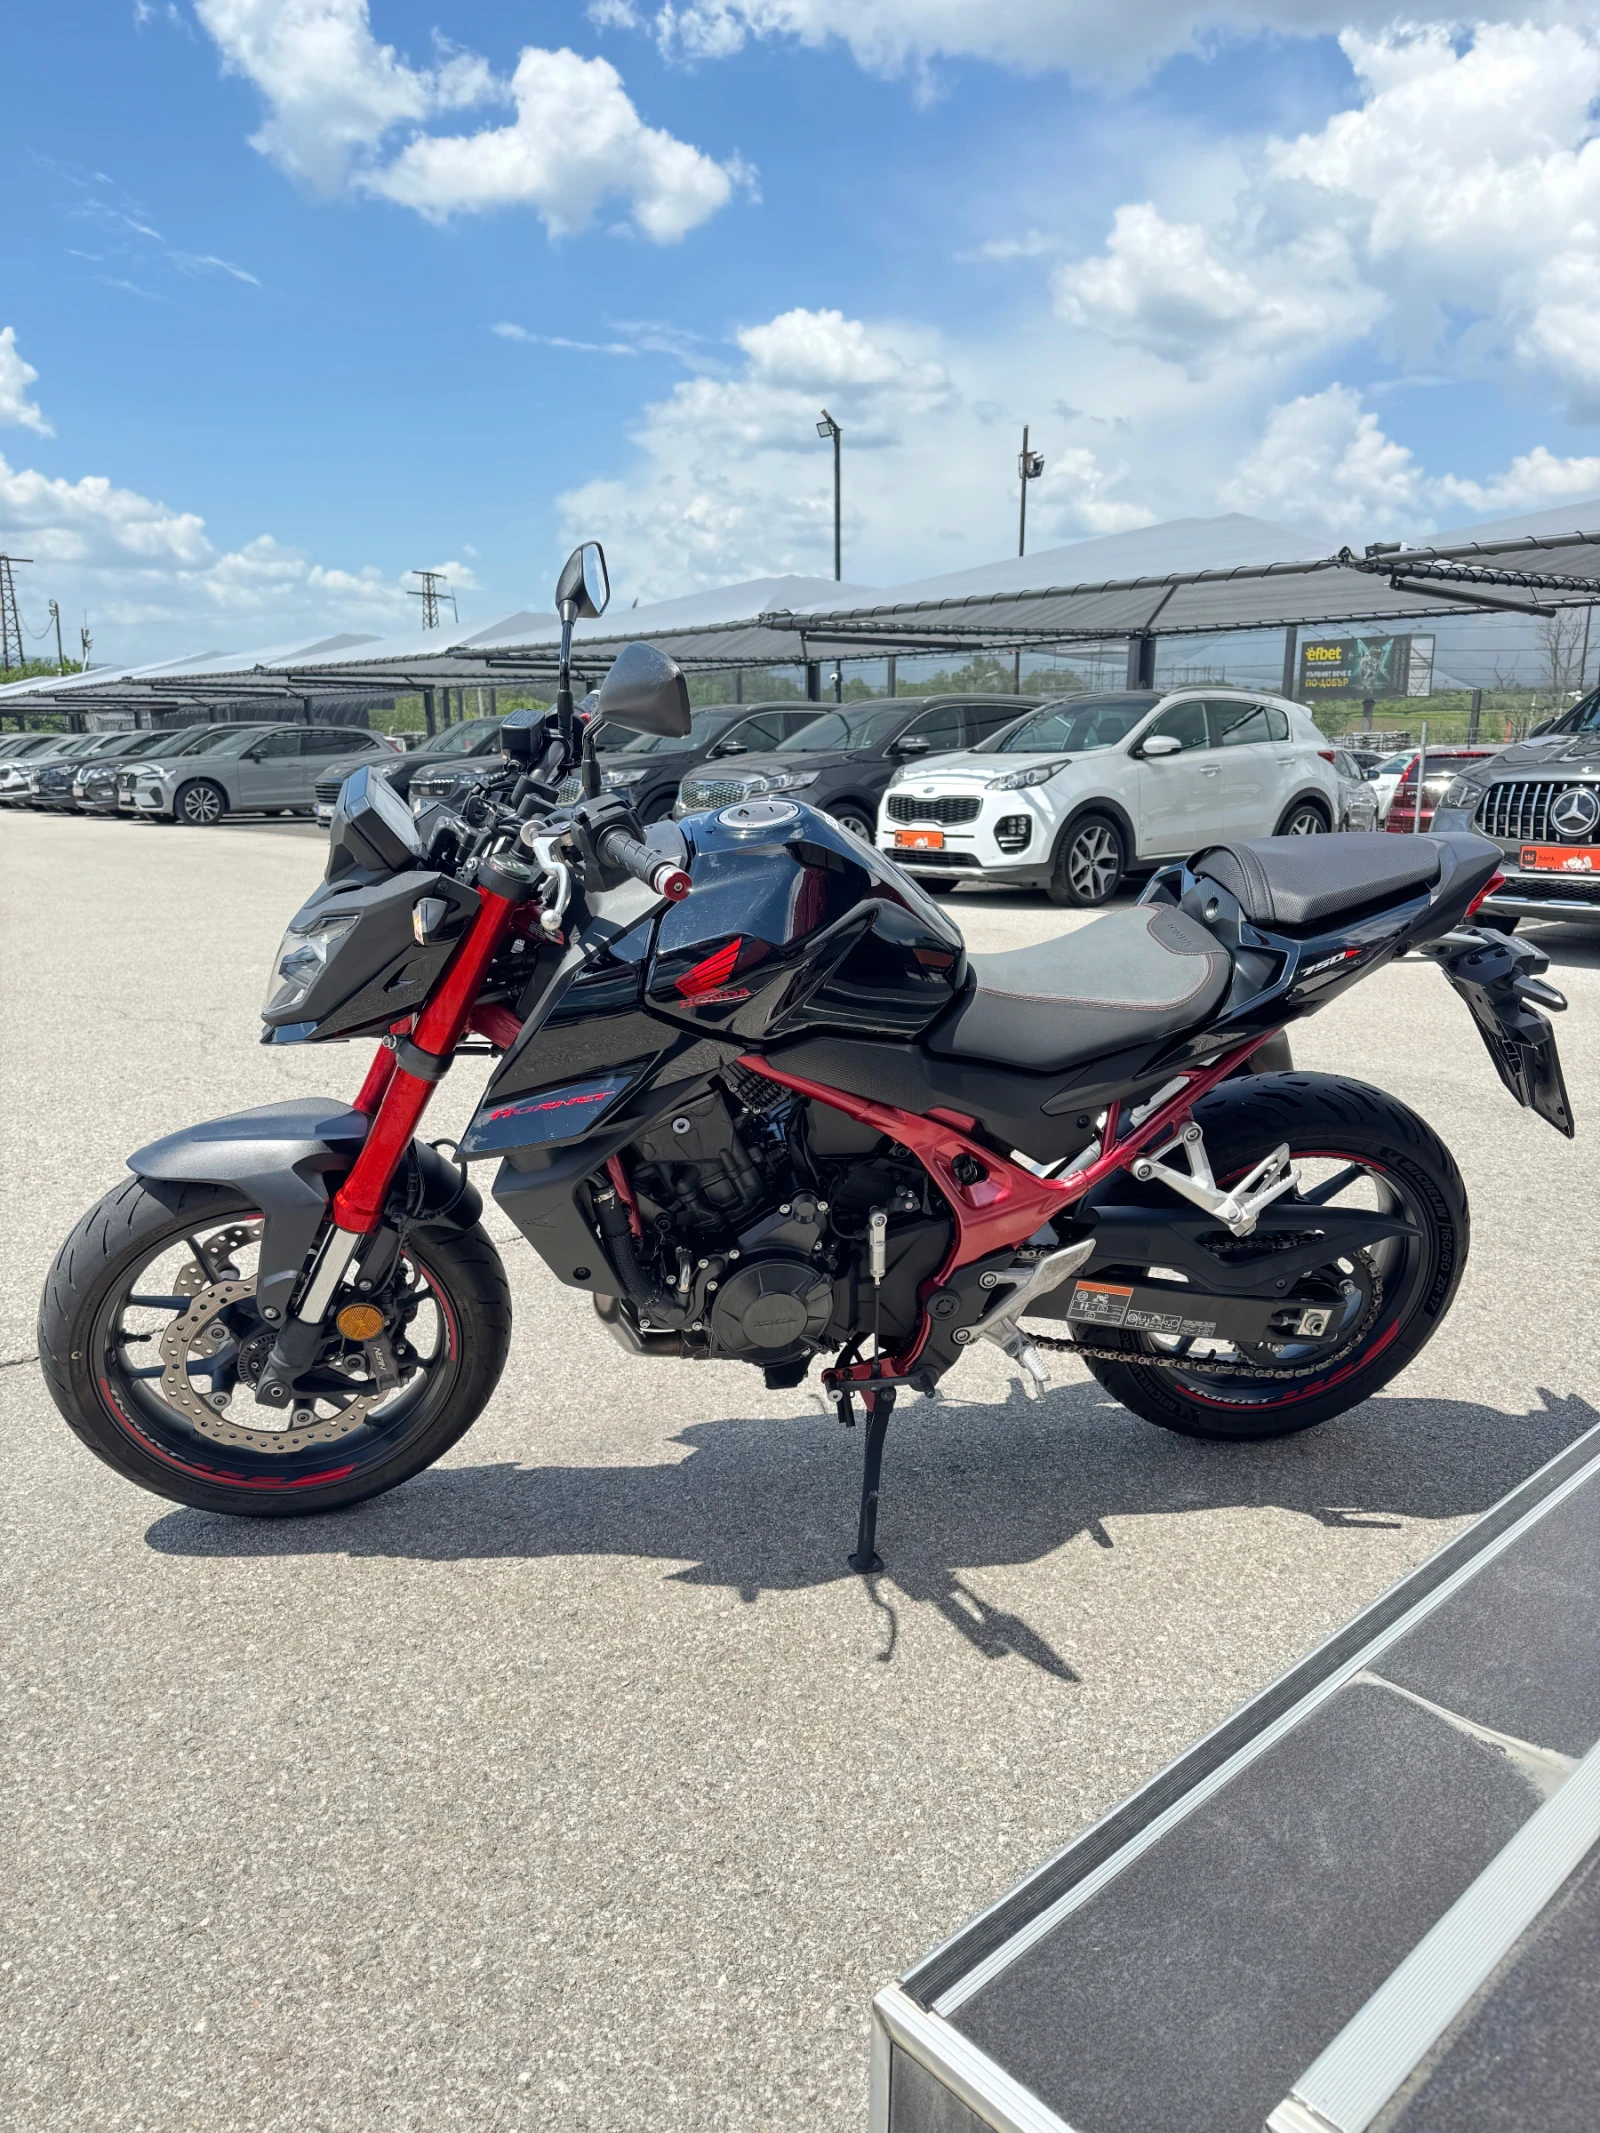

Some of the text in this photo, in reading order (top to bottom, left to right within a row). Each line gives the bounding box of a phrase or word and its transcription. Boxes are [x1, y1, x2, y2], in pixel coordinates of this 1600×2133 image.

[1305, 646, 1342, 660] efbet
[1305, 678, 1349, 688] ПО-ДОБЪР
[1301, 951, 1346, 977] 750
[679, 987, 752, 1009] HONDA
[489, 1091, 616, 1120] HORNET
[1400, 1159, 1454, 1313] MICHELIN 160/60 ZR 17
[1130, 1363, 1179, 1411] MICHELI
[1188, 1386, 1276, 1404] HORNET
